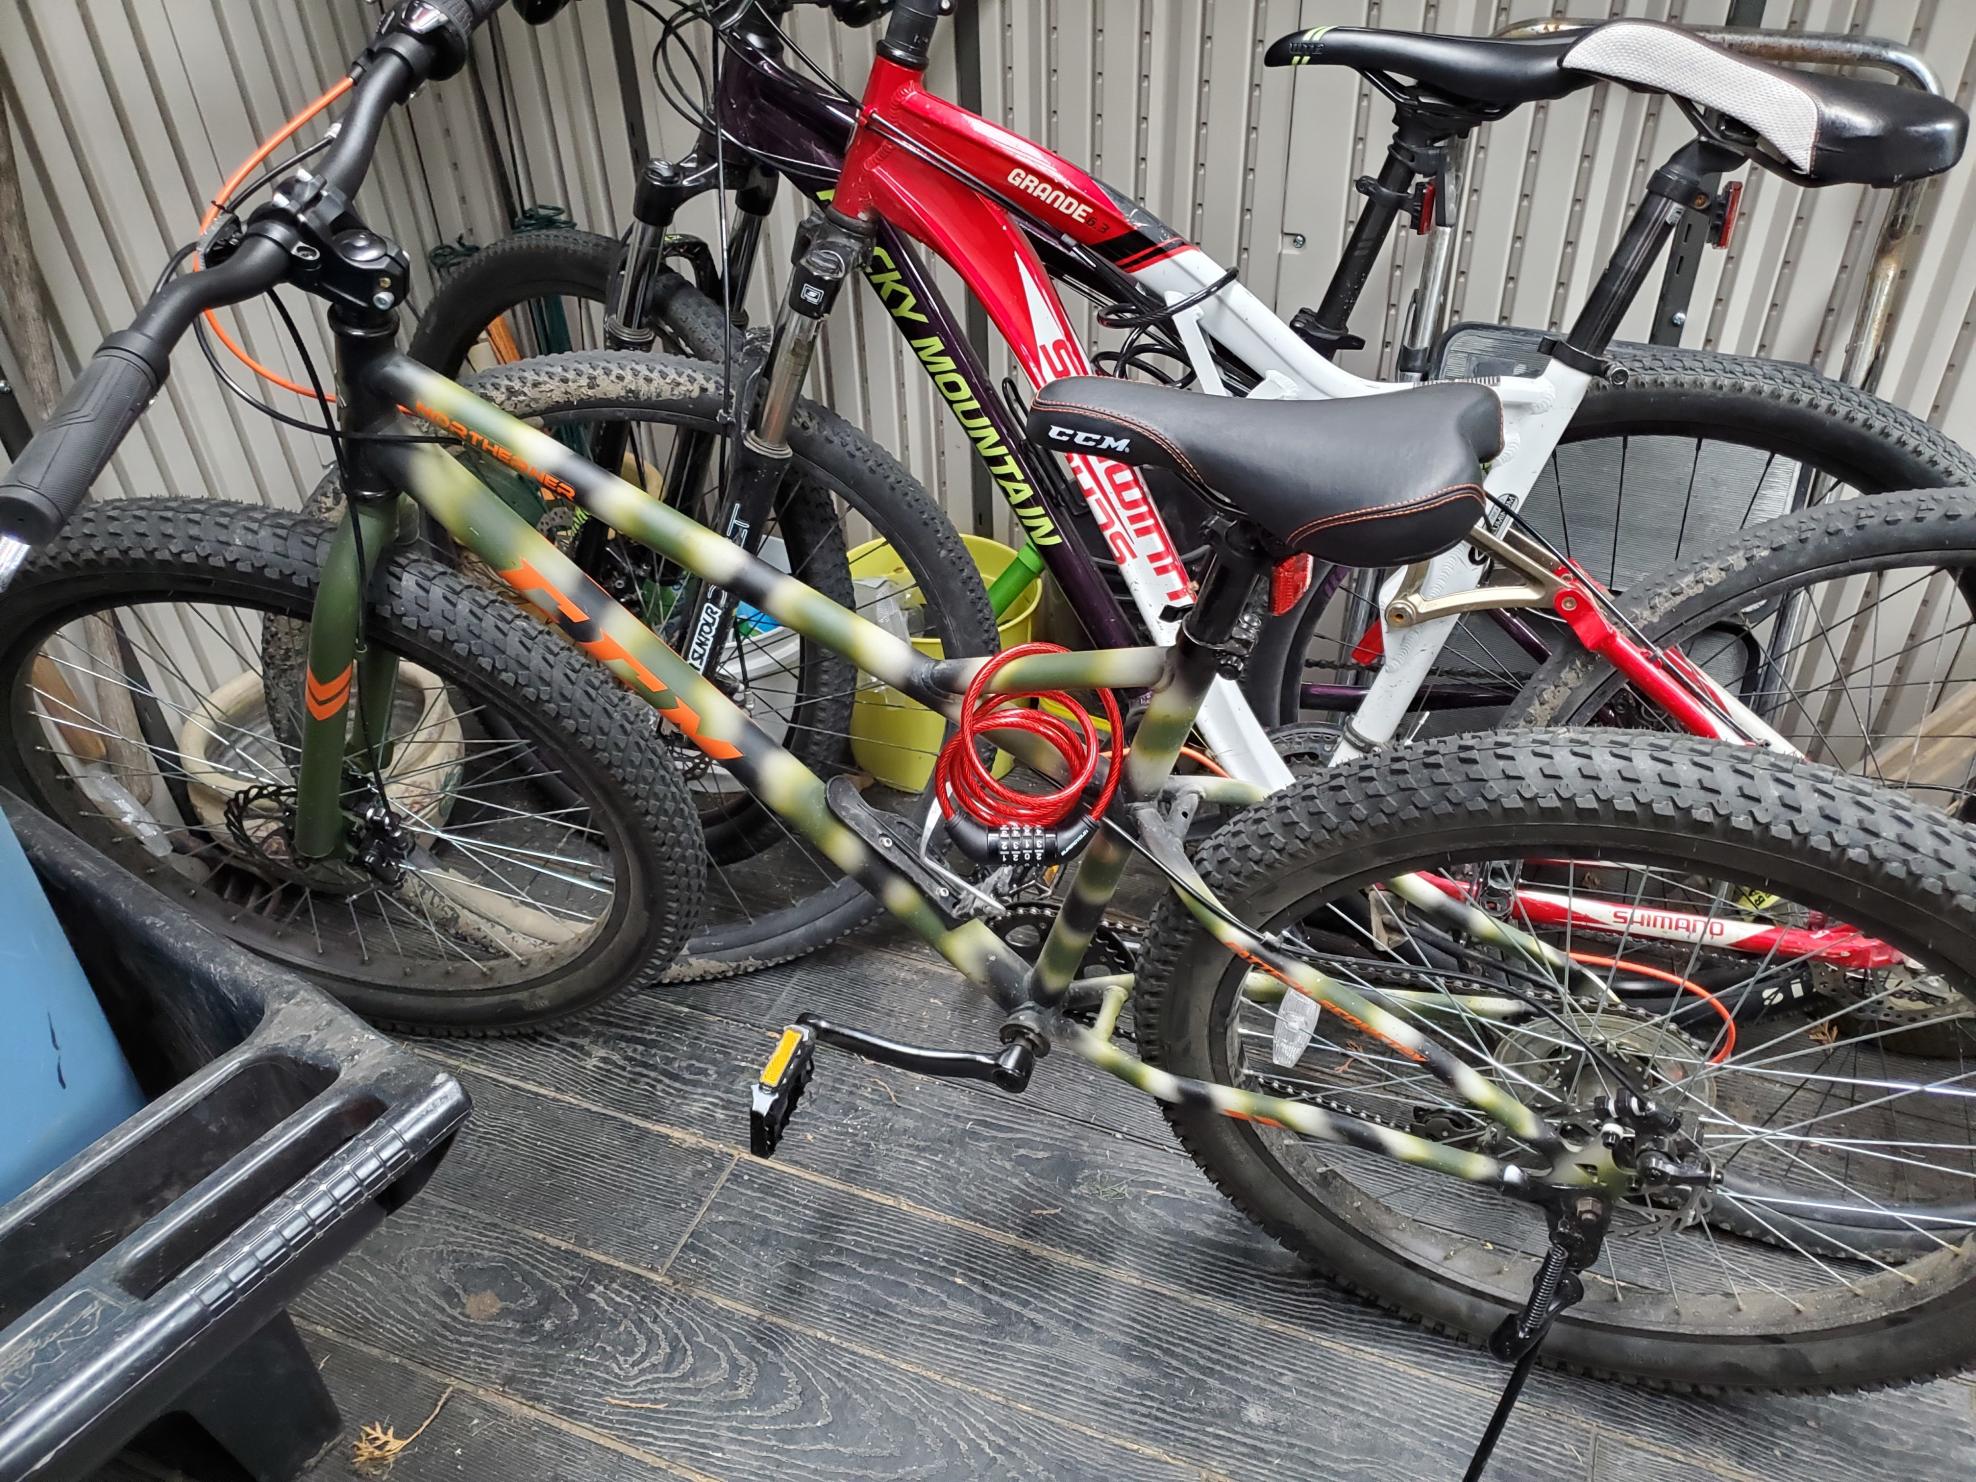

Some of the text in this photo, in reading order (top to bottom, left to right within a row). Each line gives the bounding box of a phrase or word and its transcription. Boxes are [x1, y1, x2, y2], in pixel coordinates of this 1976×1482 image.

[1007, 168, 1094, 223] GRANDE
[911, 336, 1062, 546] MOUNTAIN
[1048, 424, 1129, 453] CCM
[691, 607, 718, 665] SUNTOUR
[1612, 910, 1724, 937] SHIMANO
